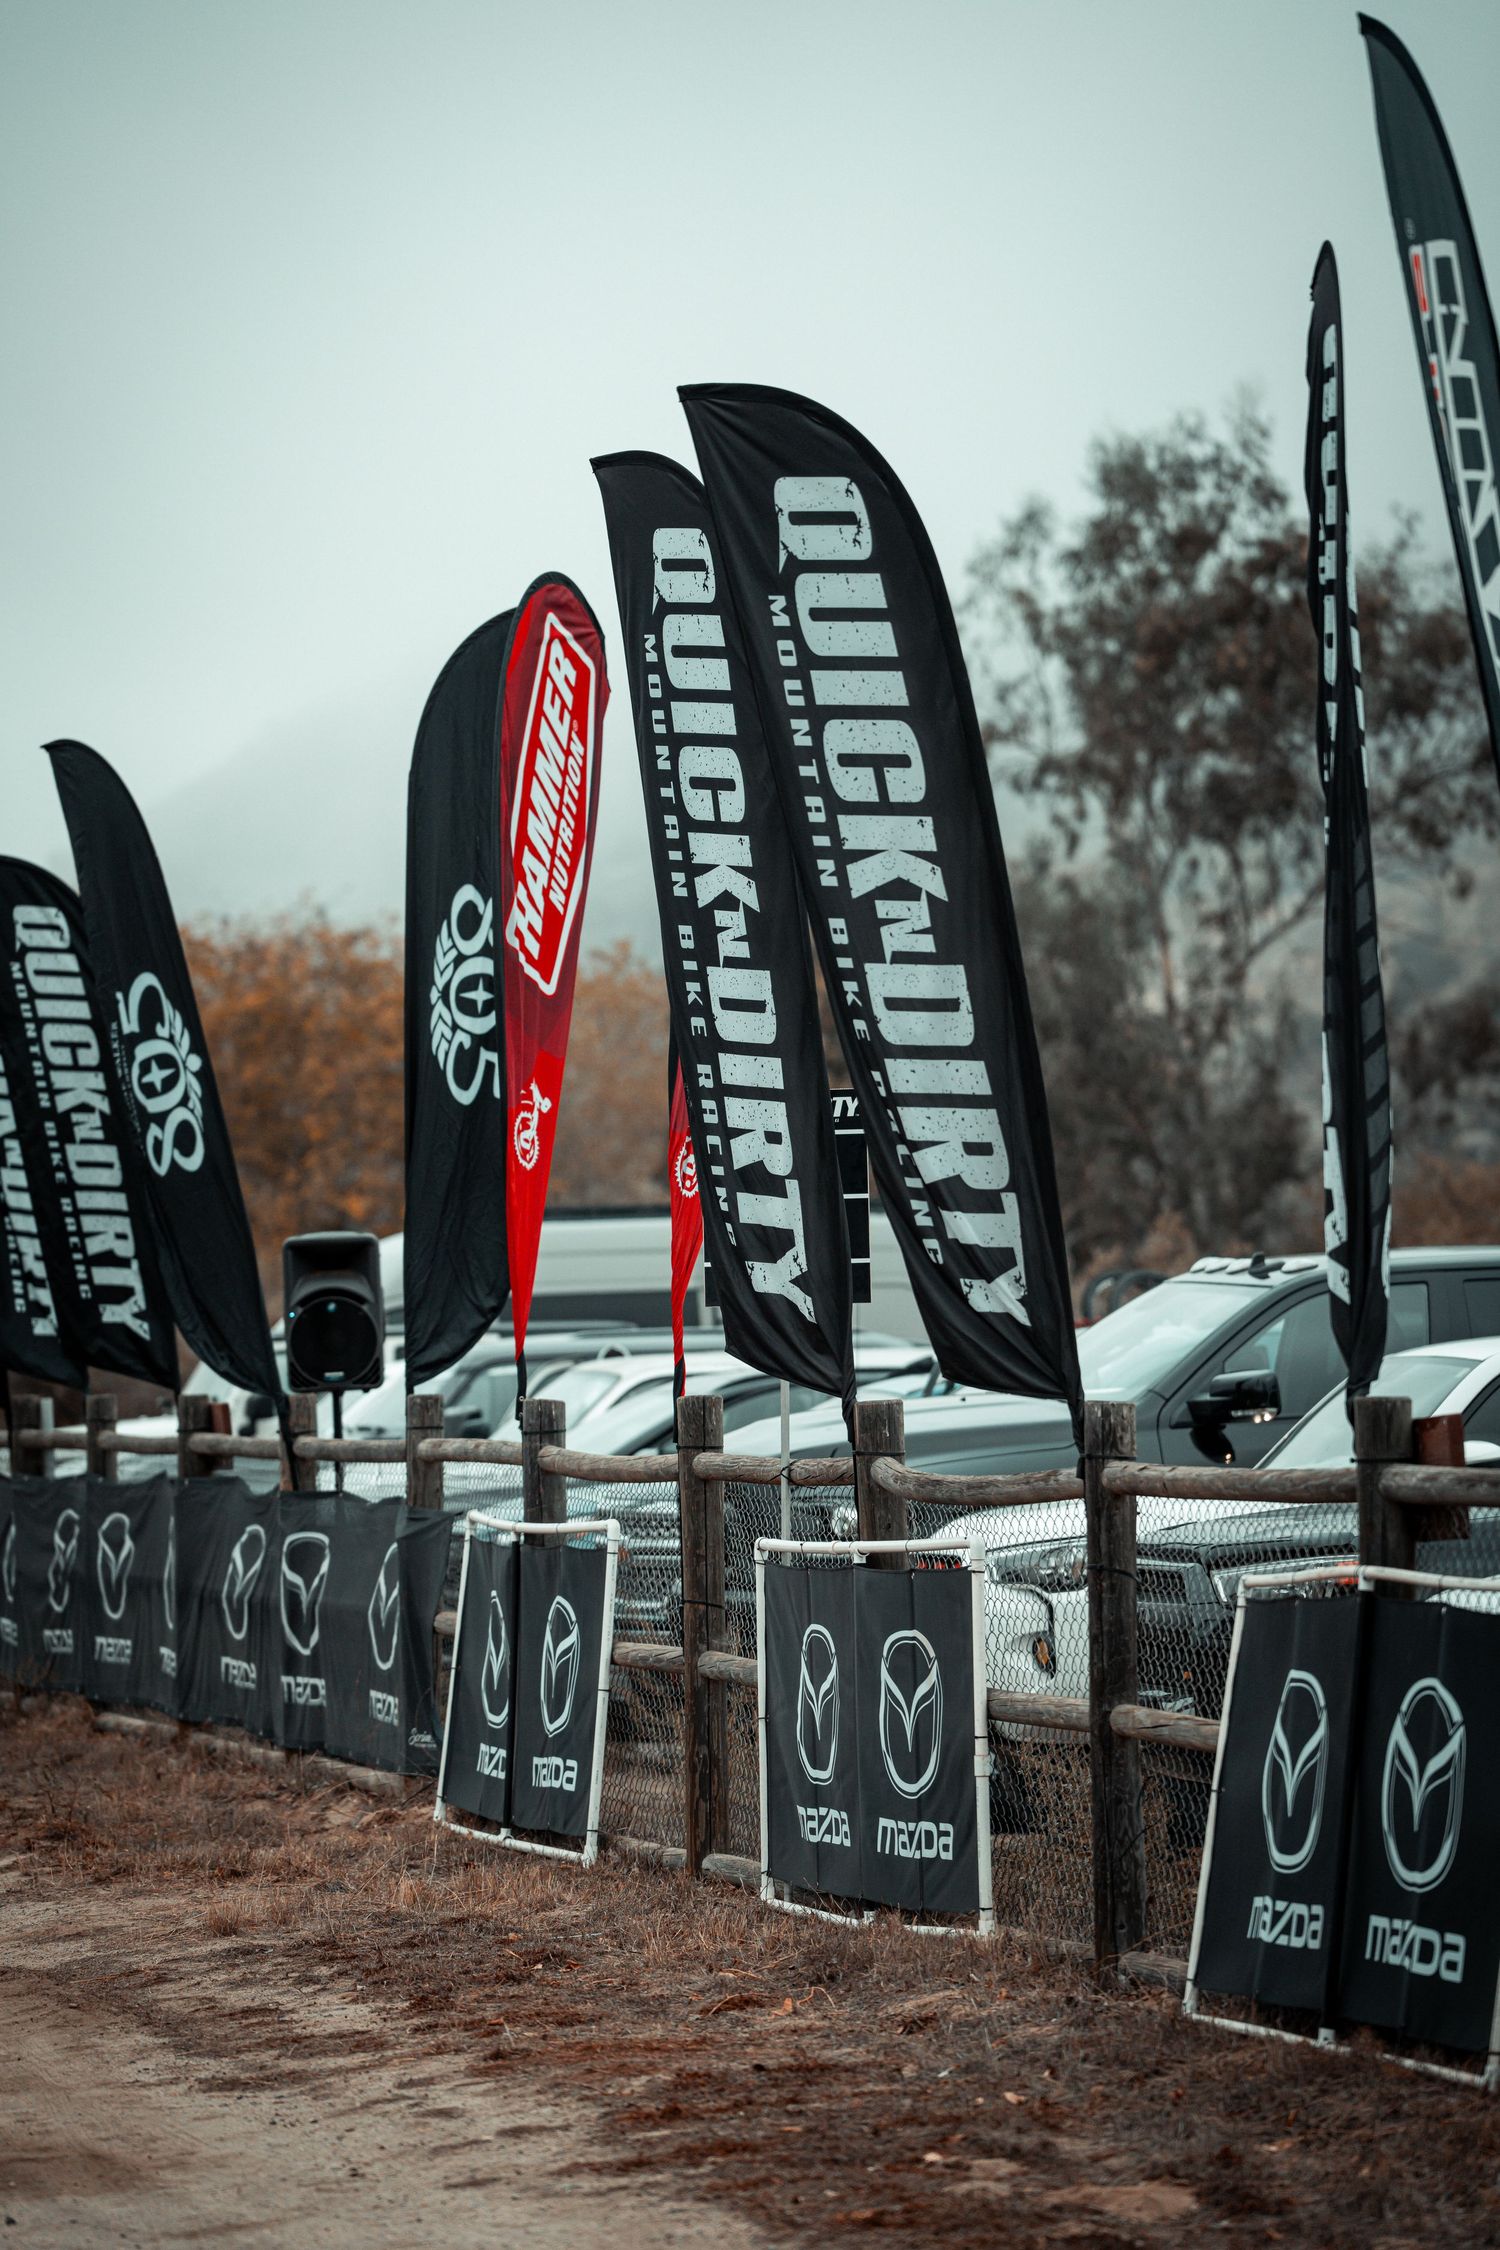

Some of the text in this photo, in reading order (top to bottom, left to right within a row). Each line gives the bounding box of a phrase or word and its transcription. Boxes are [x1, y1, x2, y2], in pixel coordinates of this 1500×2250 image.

[514, 637, 577, 960] HAMMER
[549, 737, 585, 916] NUTRITION
[644, 634, 737, 1247] MOUNTAIN BIKE RACING
[768, 595, 838, 887] MOUNTAIN
[828, 917, 871, 1042] BIKE
[10, 960, 92, 1300] MOUNTAIN BIKE RACING
